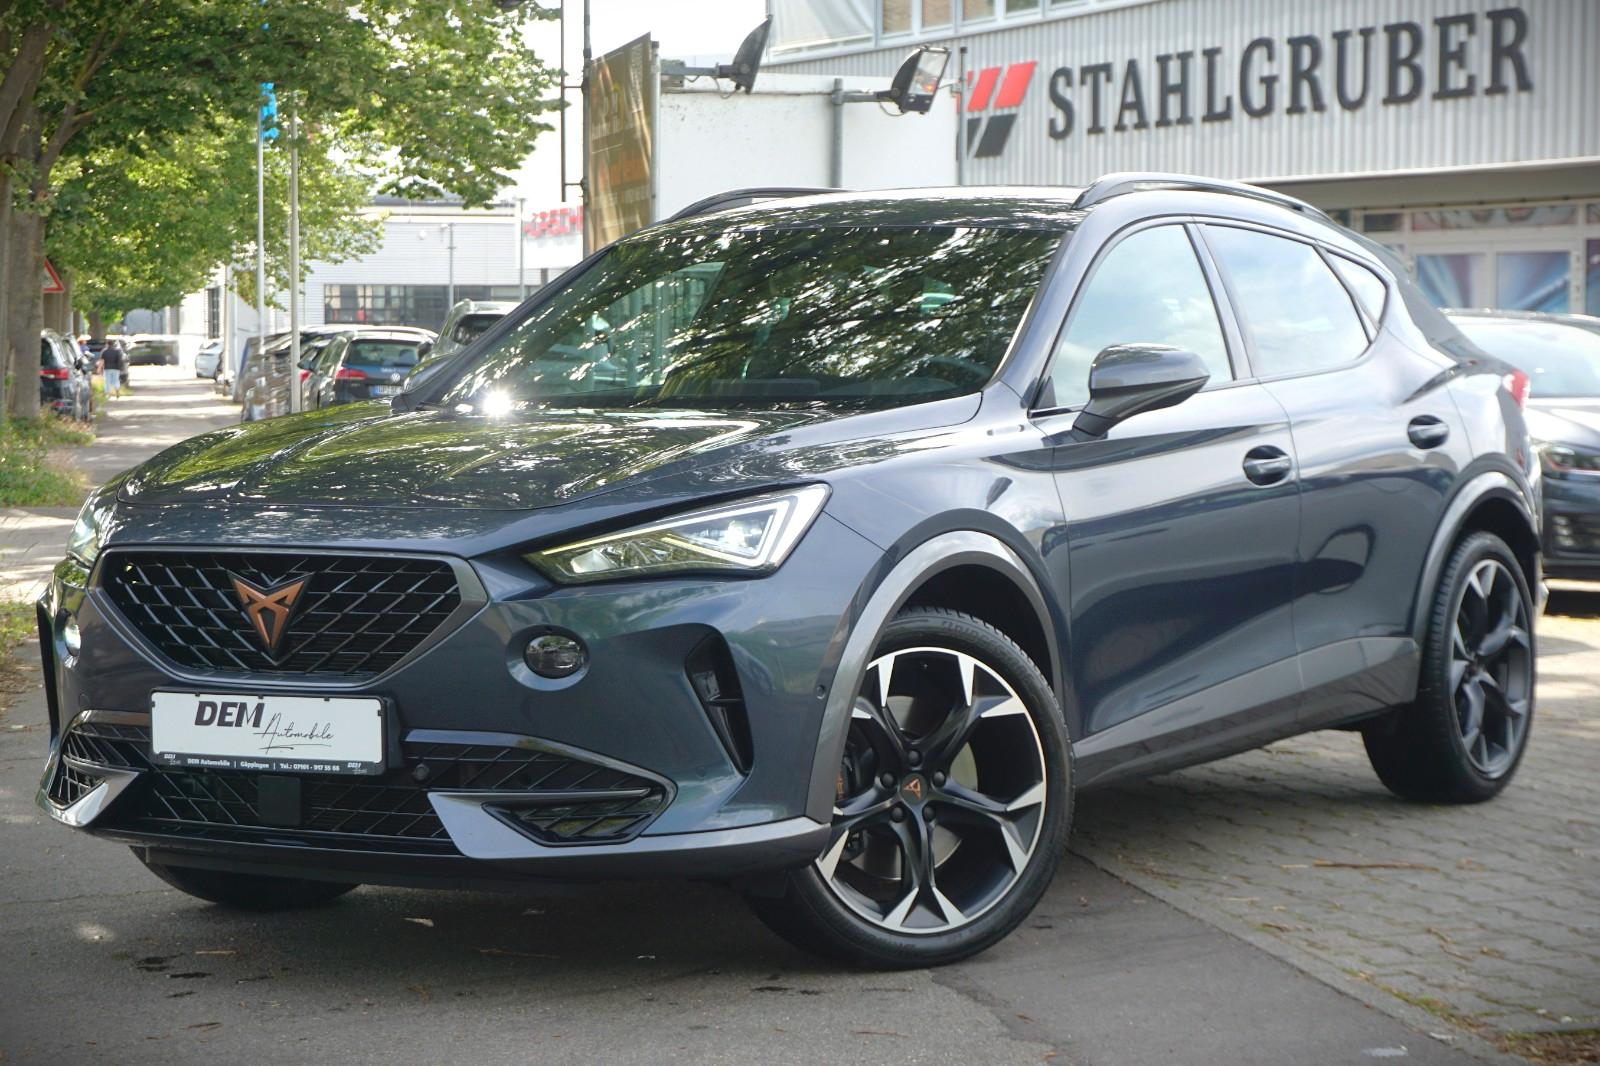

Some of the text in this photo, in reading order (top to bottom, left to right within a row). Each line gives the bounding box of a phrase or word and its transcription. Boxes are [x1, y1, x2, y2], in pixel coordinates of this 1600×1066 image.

[1048, 6, 1534, 140] STAHLGRUBER
[194, 700, 265, 728] DEM
[253, 712, 335, 754] Automobile
[200, 759, 231, 767] Automobile
[240, 761, 270, 769] Göppingen
